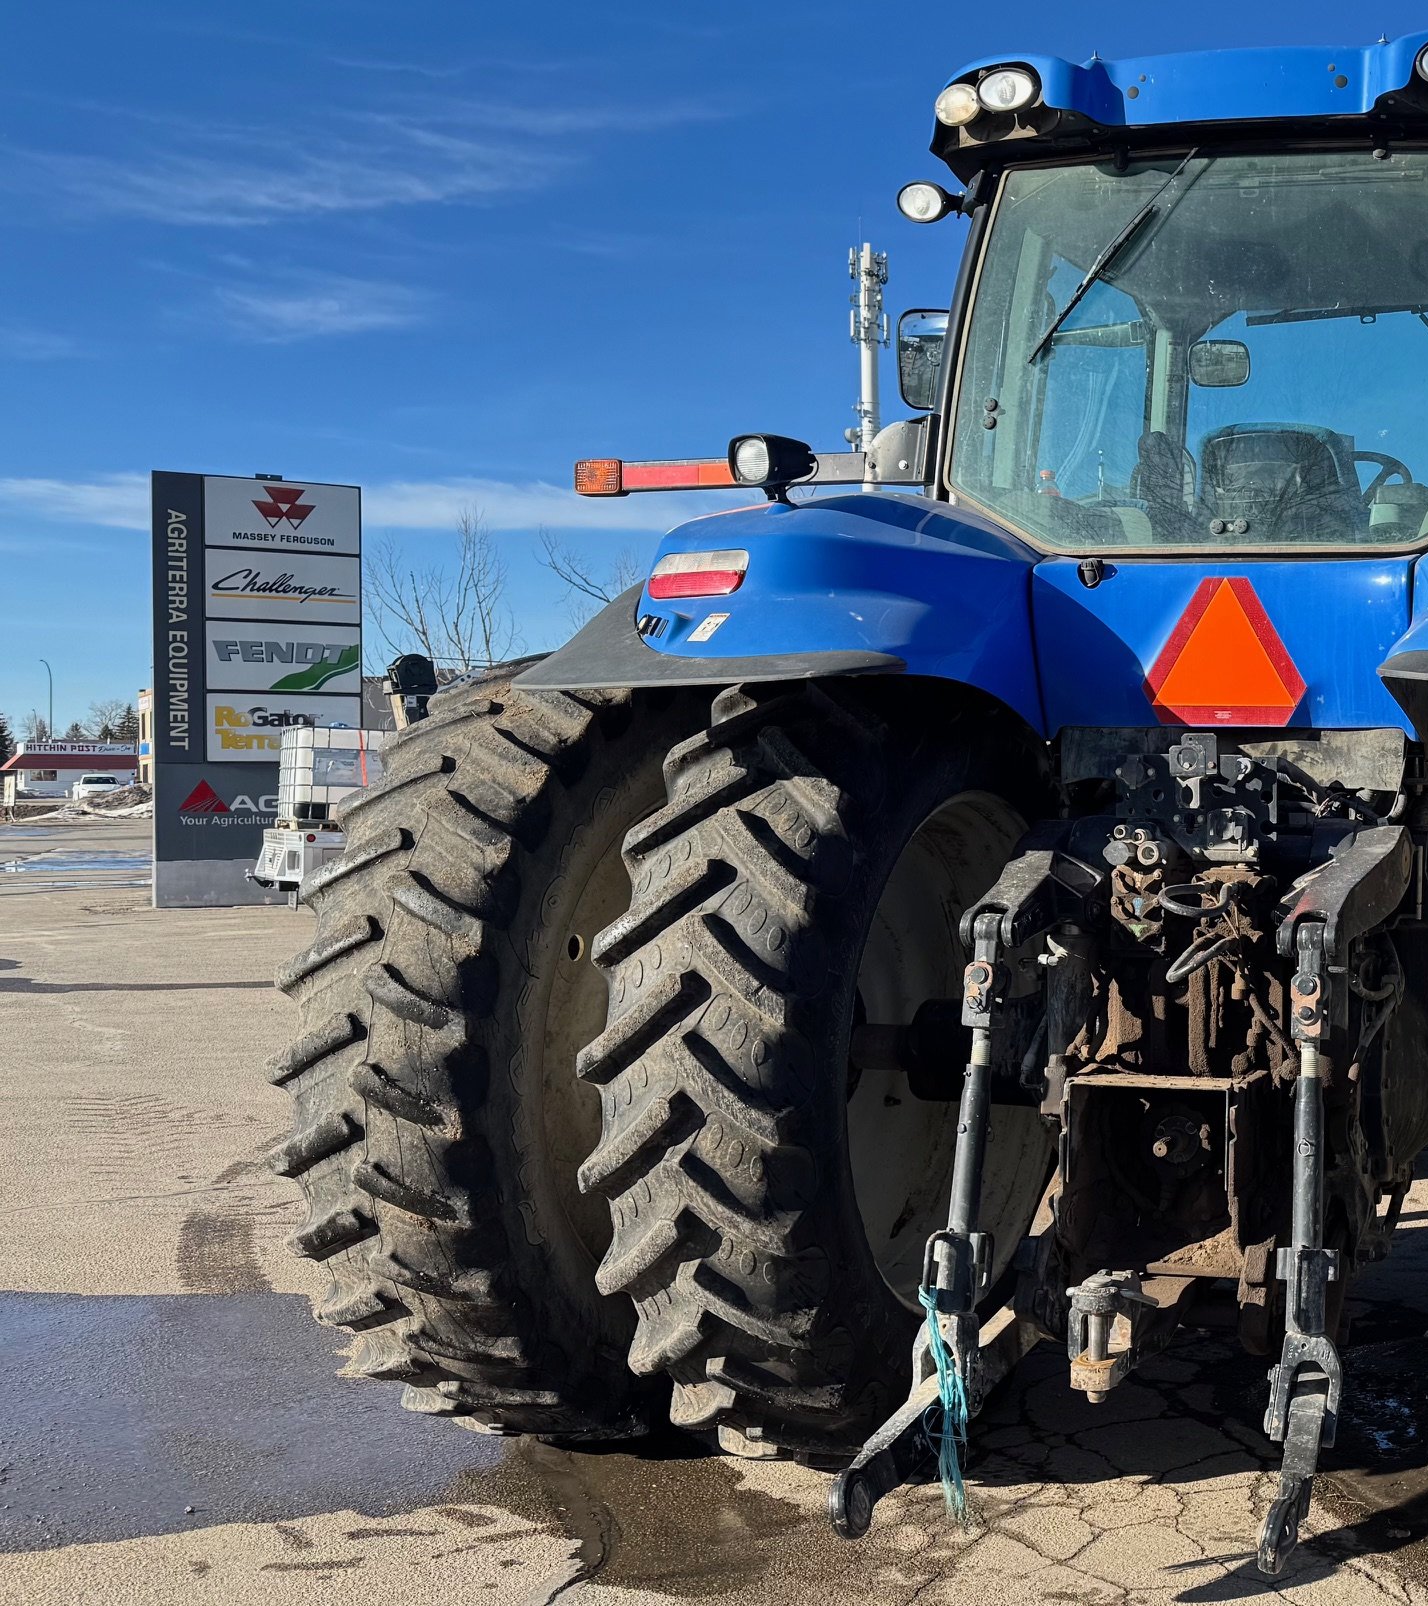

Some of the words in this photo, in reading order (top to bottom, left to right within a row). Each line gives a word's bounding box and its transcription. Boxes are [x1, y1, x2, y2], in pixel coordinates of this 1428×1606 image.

[232, 531, 276, 542] MASSEY
[280, 534, 335, 546] FERGUSON
[167, 508, 188, 624] AGRITERRA
[211, 568, 357, 604] Challenger
[212, 640, 352, 665] FENDT
[168, 630, 189, 751] EQUIPMENT
[214, 706, 320, 727] RoGator
[26, 744, 67, 752] HITCHIN
[70, 744, 98, 753] POST
[215, 728, 281, 750] Terra
[229, 794, 279, 812] AG
[180, 815, 212, 826] Your
[213, 814, 274, 828] Agricultur
